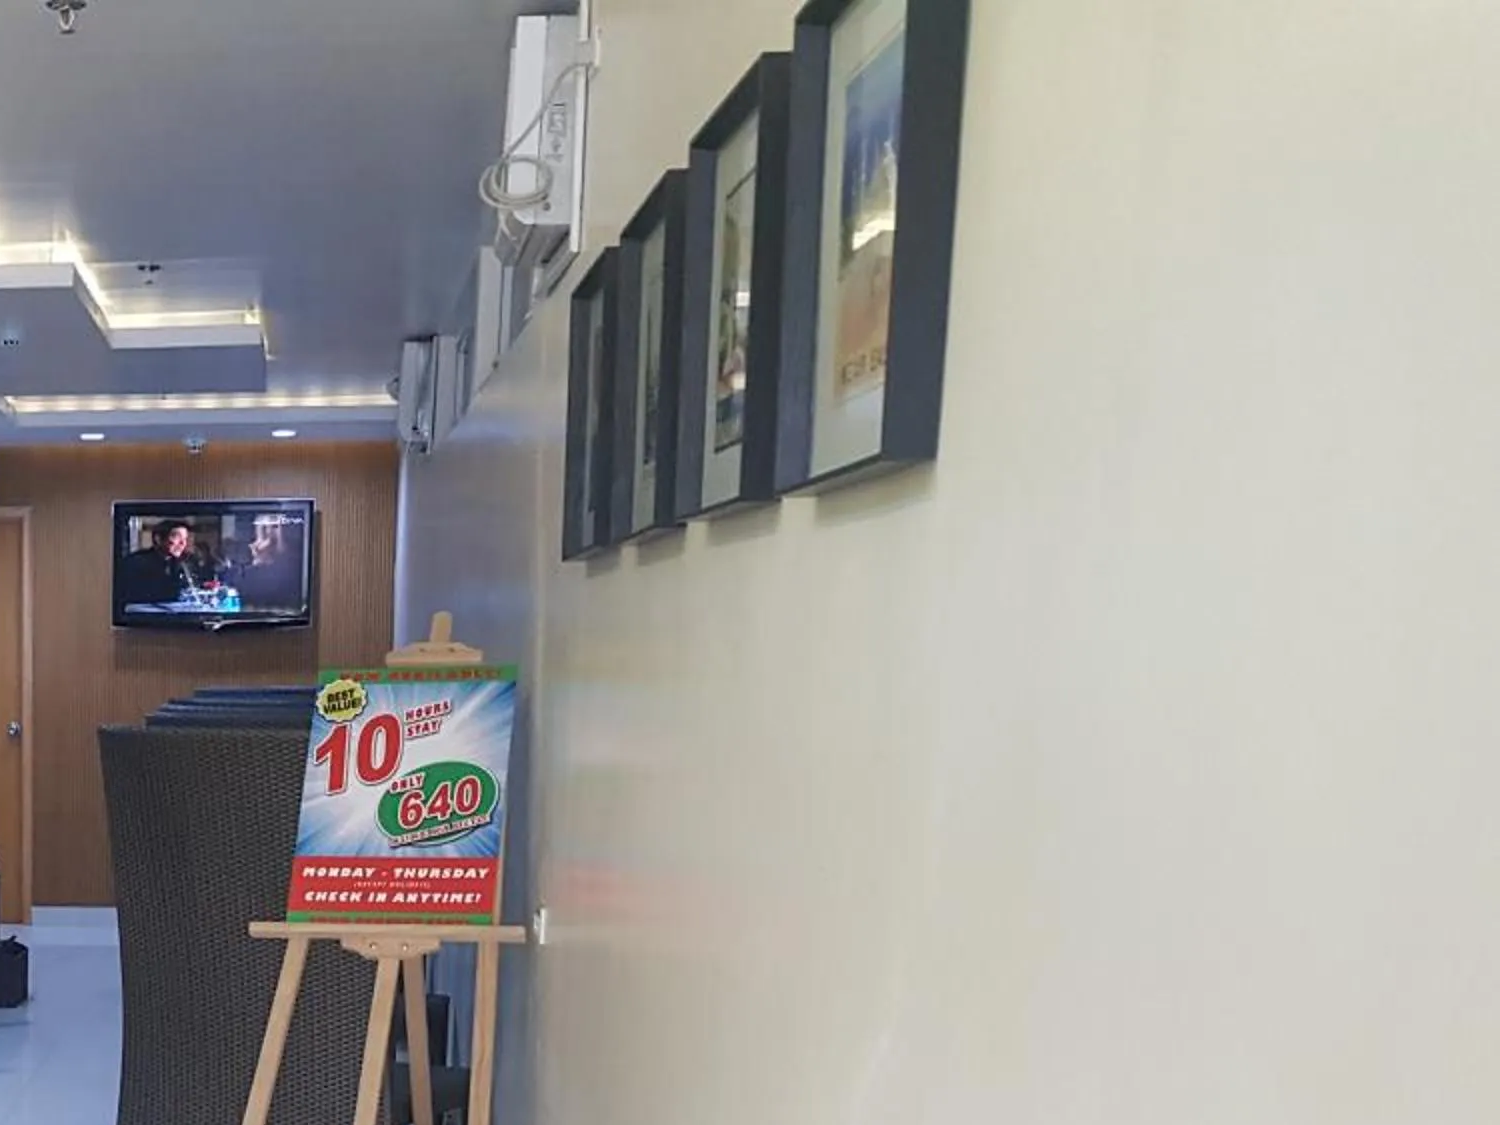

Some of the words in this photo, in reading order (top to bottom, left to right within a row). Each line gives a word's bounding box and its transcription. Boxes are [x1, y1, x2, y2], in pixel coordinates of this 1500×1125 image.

[327, 688, 355, 702] BEST
[405, 701, 451, 721] HOURS
[316, 713, 402, 794] 10
[390, 774, 425, 791] ONLY
[399, 776, 481, 828] 640
[302, 867, 375, 878] MONDAY
[393, 867, 489, 879] THURSDAY
[304, 891, 363, 902] CHECK
[367, 892, 387, 902] IN
[392, 892, 482, 904] ANYTIME!
